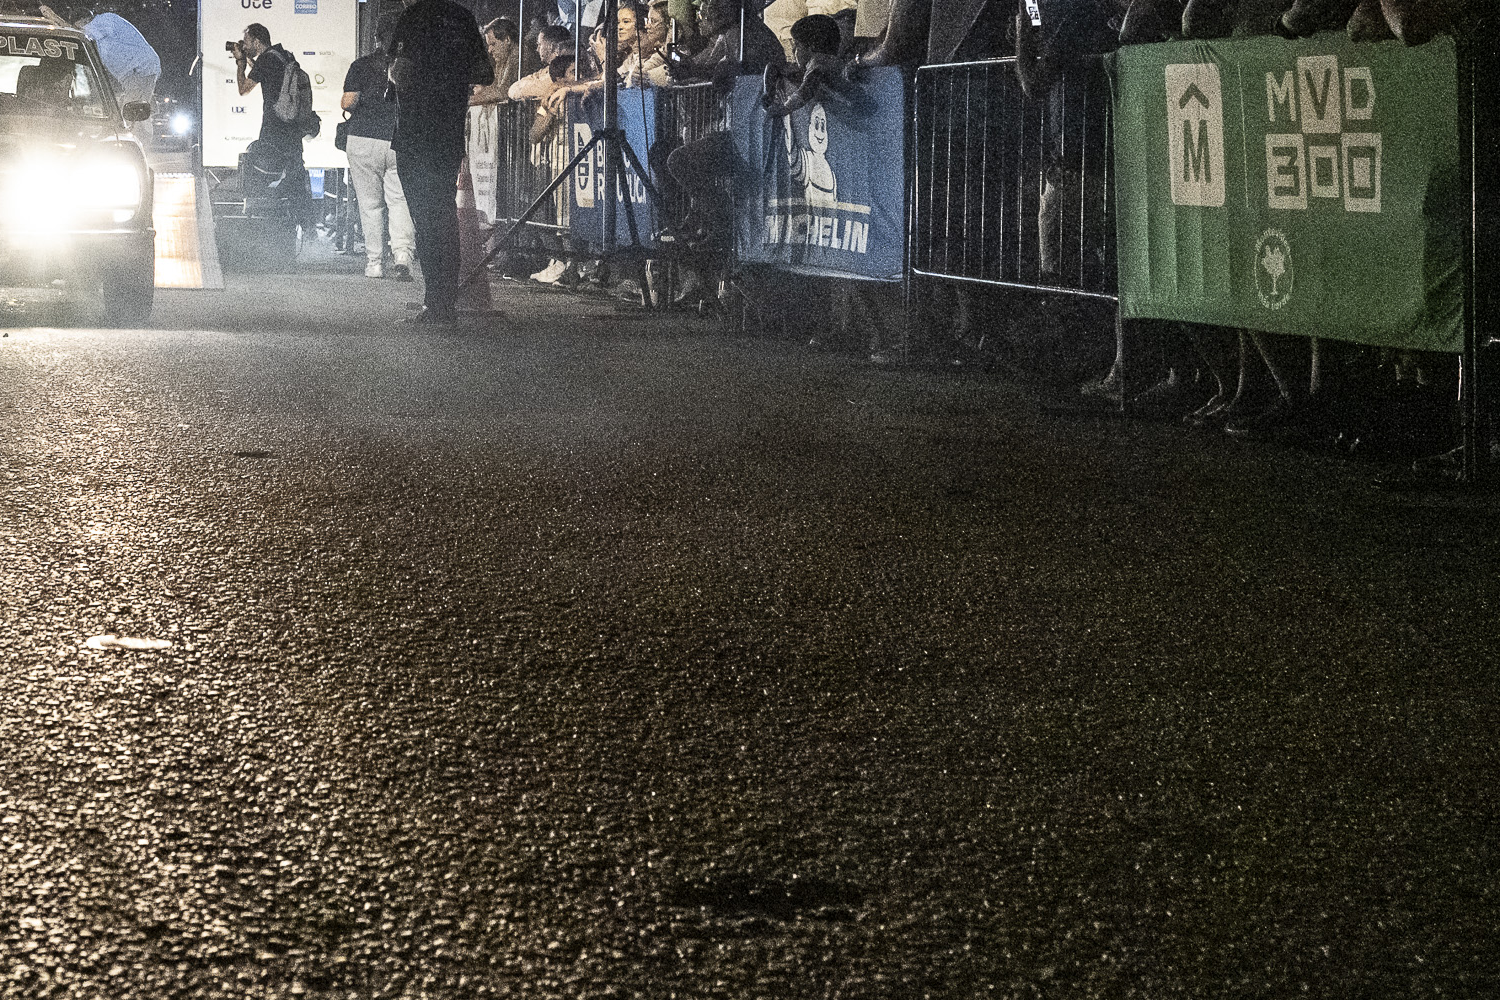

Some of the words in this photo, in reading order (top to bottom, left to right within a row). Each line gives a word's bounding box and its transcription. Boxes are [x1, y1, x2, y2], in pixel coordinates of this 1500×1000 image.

[1265, 54, 1377, 134] MVD
[1265, 132, 1383, 214] 300
[765, 213, 871, 254] MICHELIN
